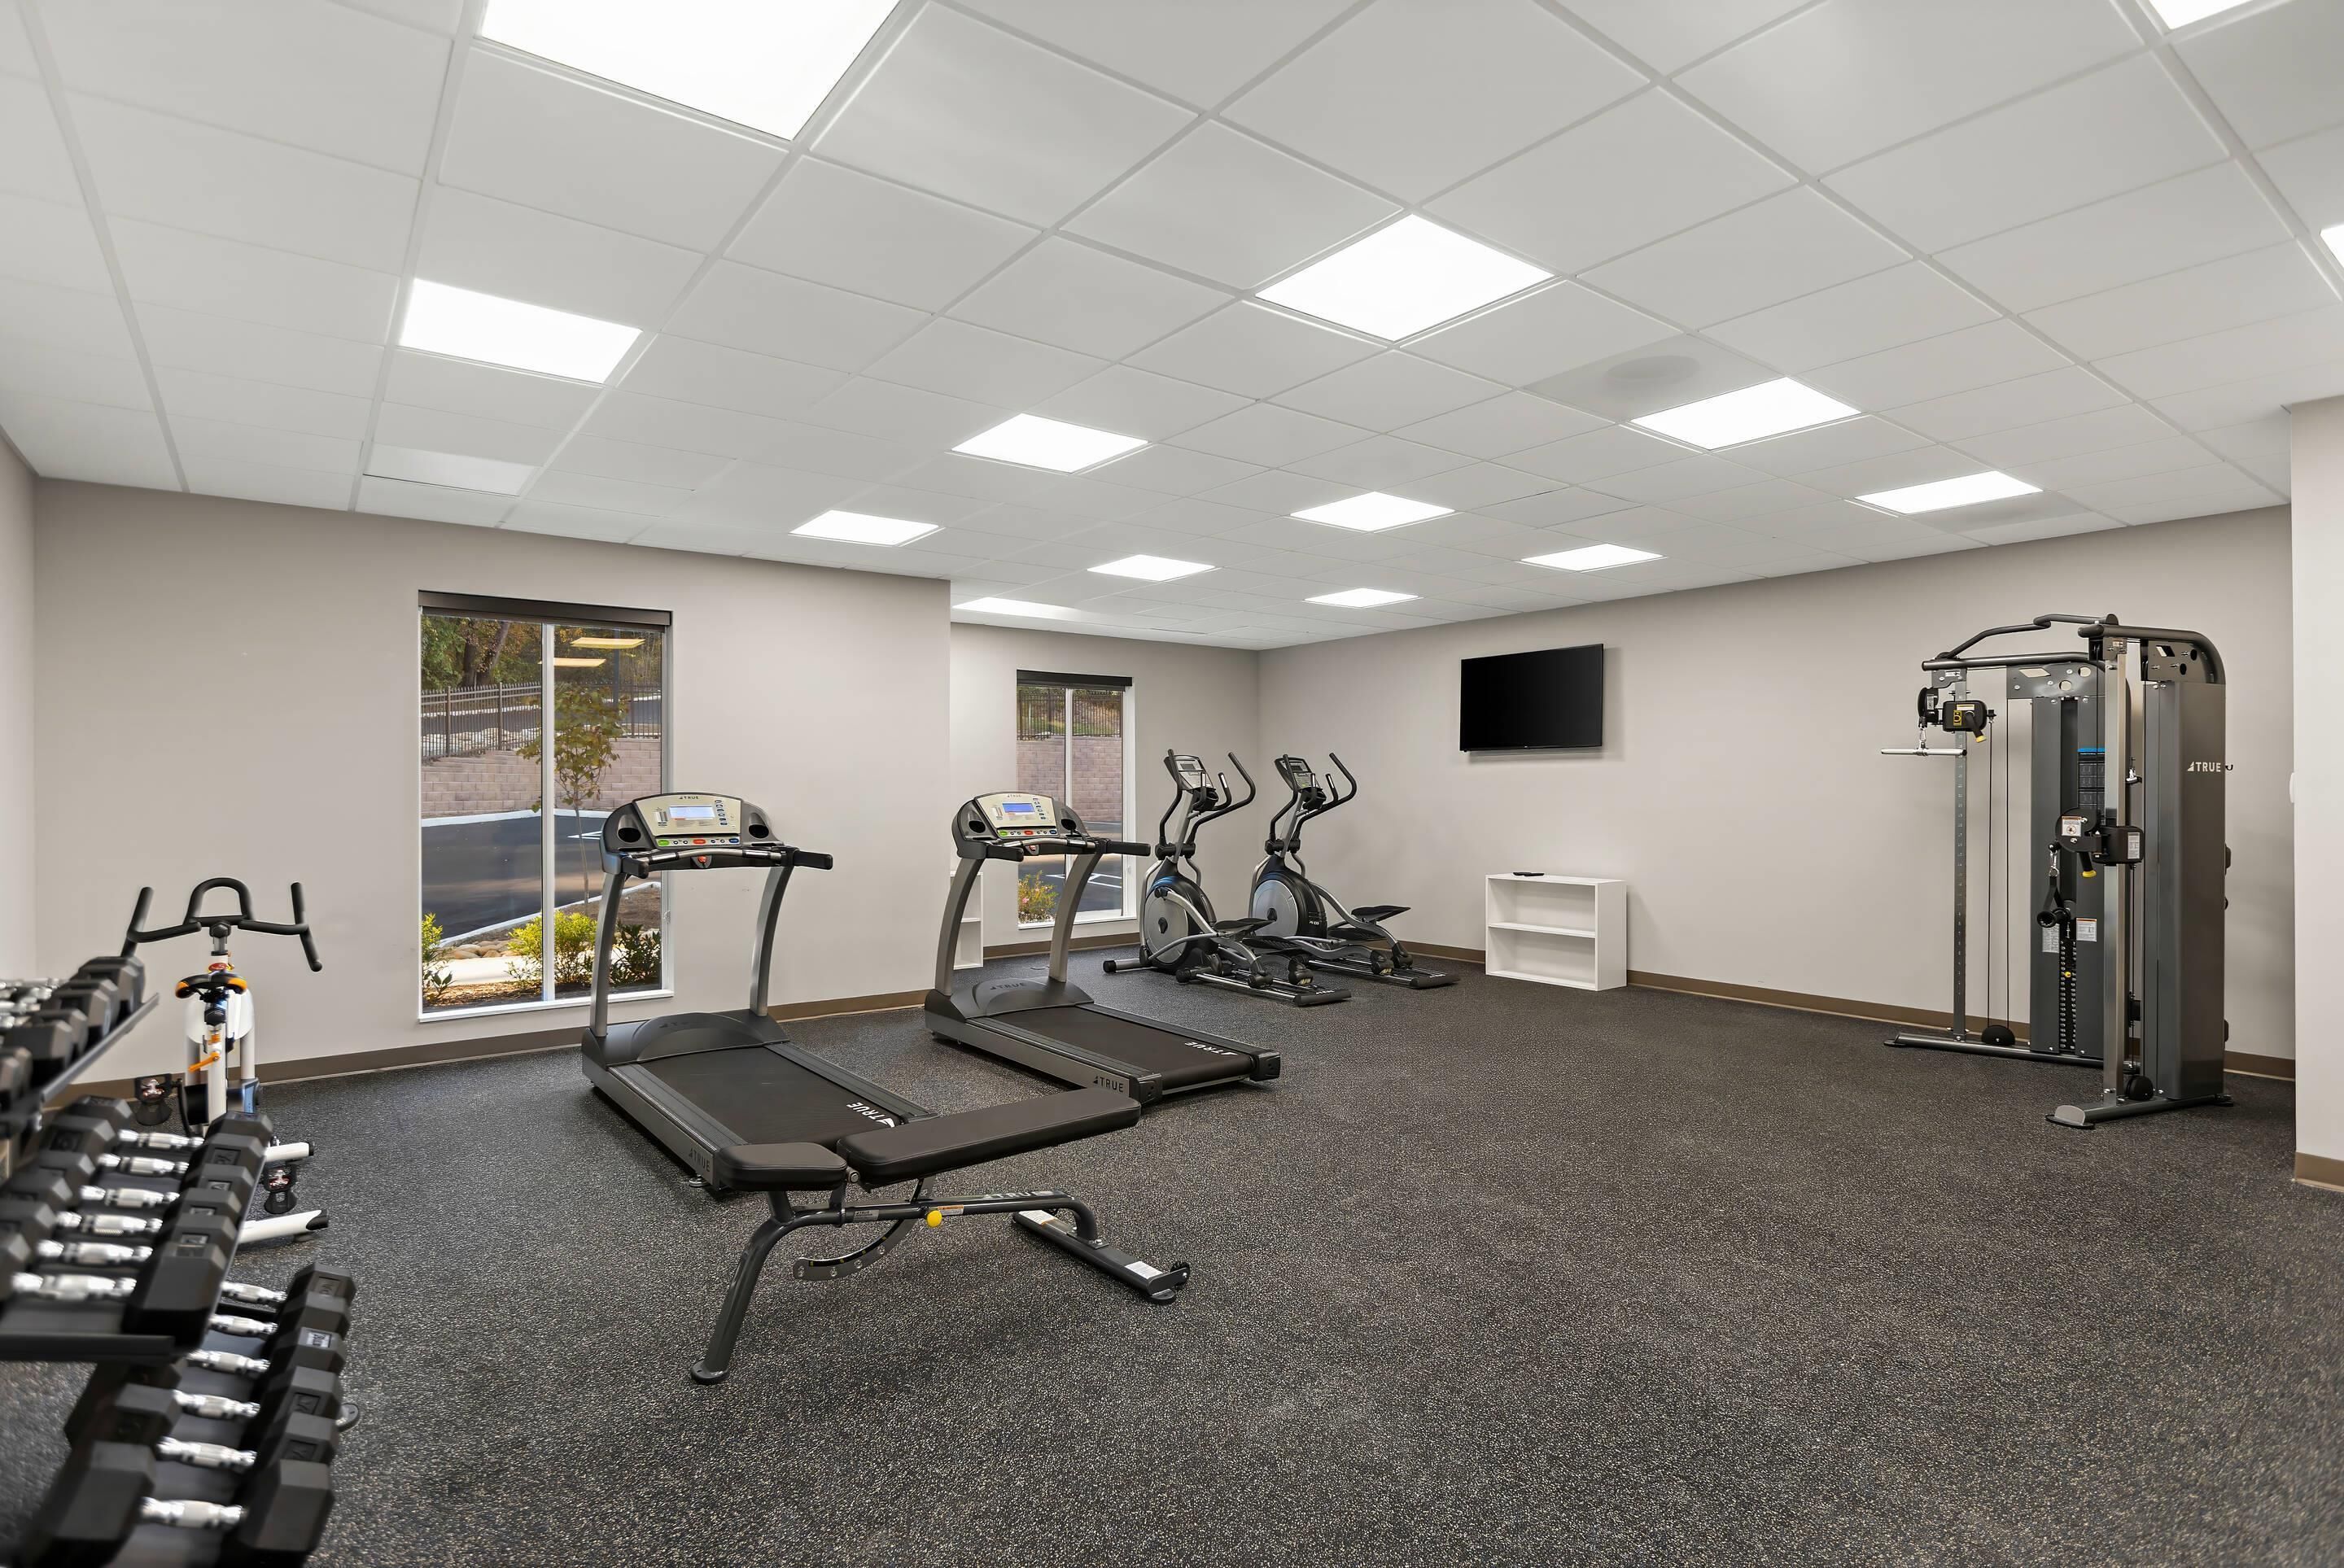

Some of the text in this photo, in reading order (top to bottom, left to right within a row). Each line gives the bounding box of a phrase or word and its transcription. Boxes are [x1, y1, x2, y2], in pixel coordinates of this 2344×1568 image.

[2195, 762, 2221, 772] TRUE
[1184, 1042, 1223, 1054] TRUE
[1100, 1077, 1124, 1093] TRUE
[846, 1102, 886, 1120] TRUE
[693, 1148, 711, 1173] TRUE
